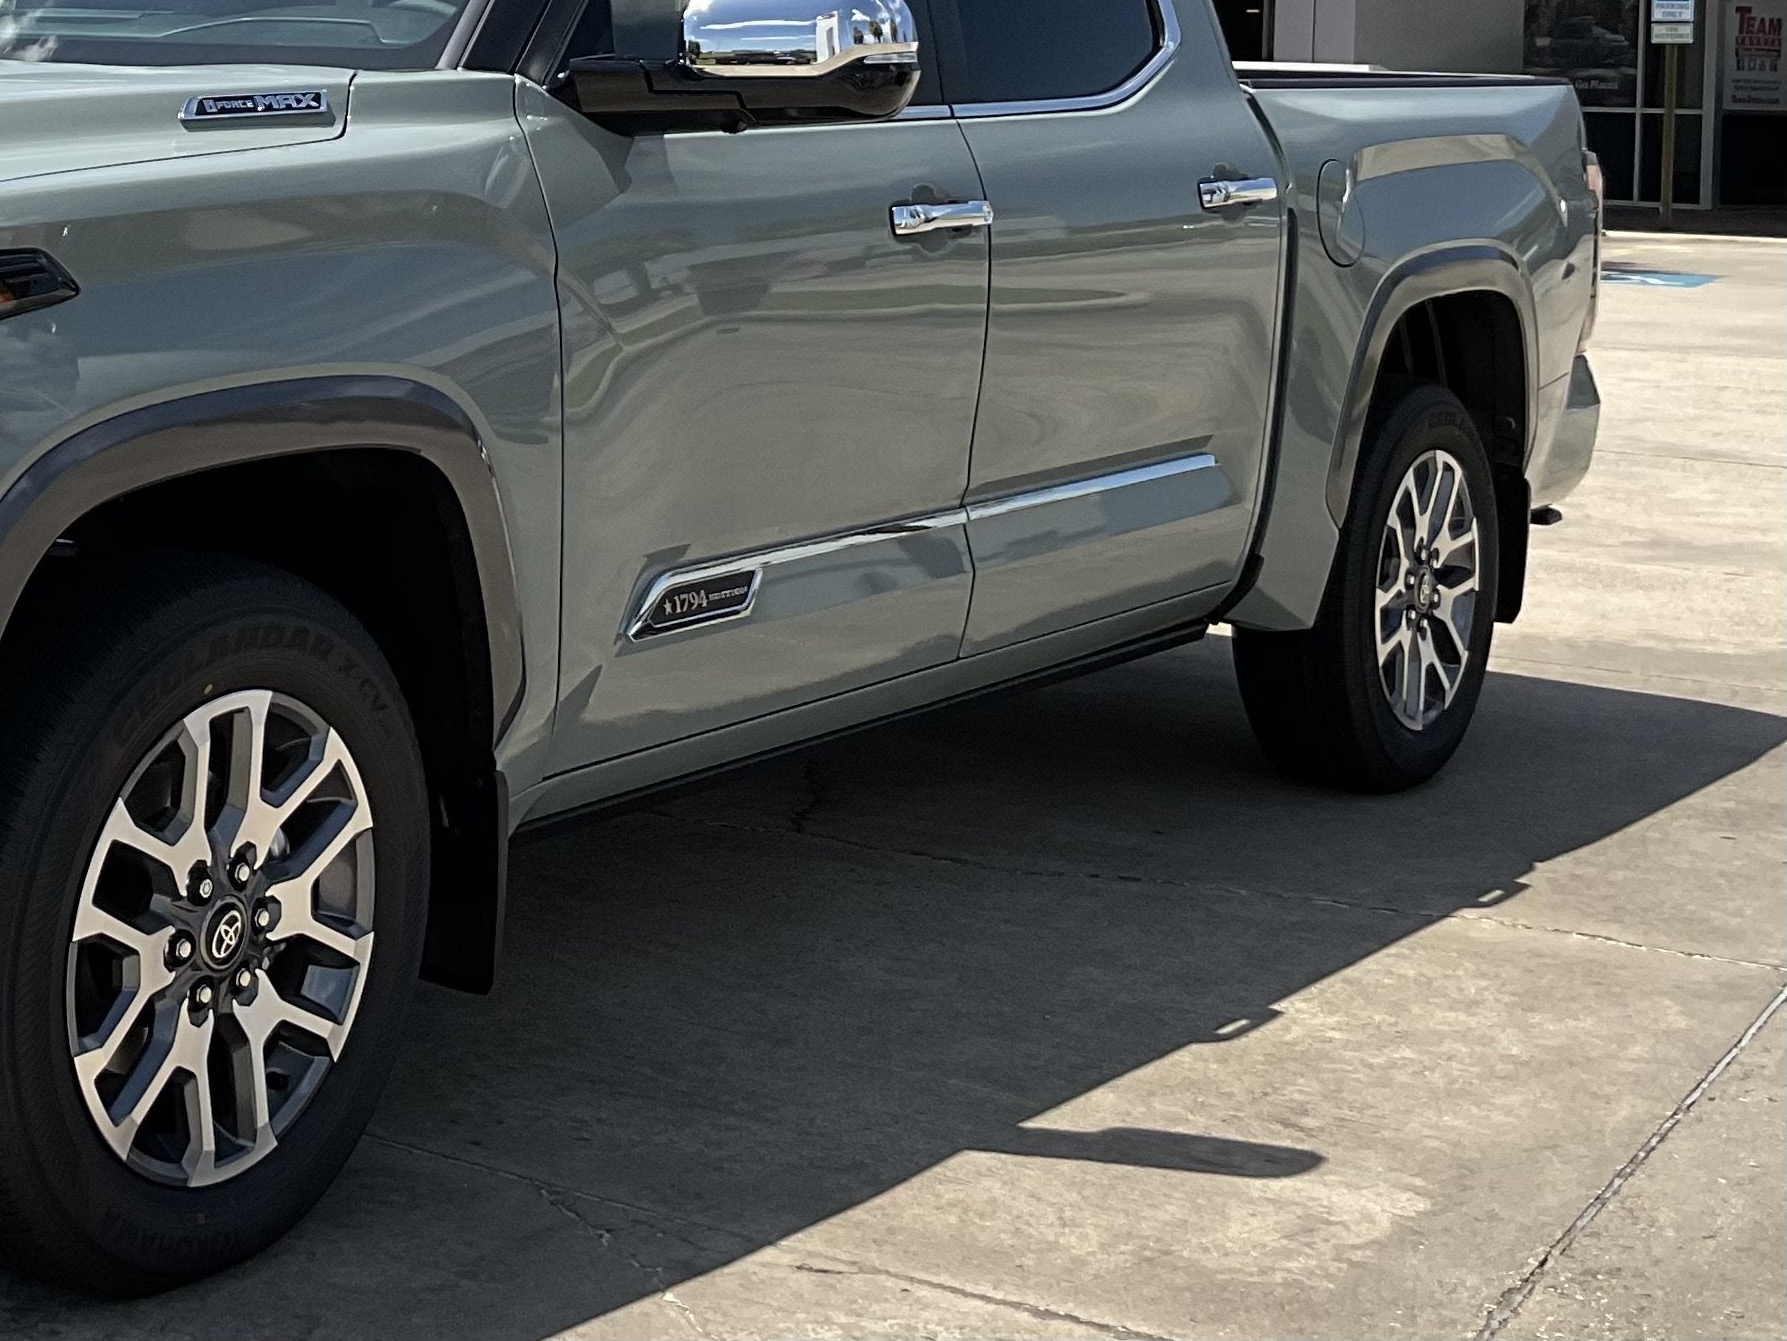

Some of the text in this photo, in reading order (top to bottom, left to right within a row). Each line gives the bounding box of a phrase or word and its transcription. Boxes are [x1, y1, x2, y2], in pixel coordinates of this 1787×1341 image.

[1735, 6, 1782, 36] TEAM
[253, 92, 320, 110] MAX
[674, 589, 708, 613] 1794
